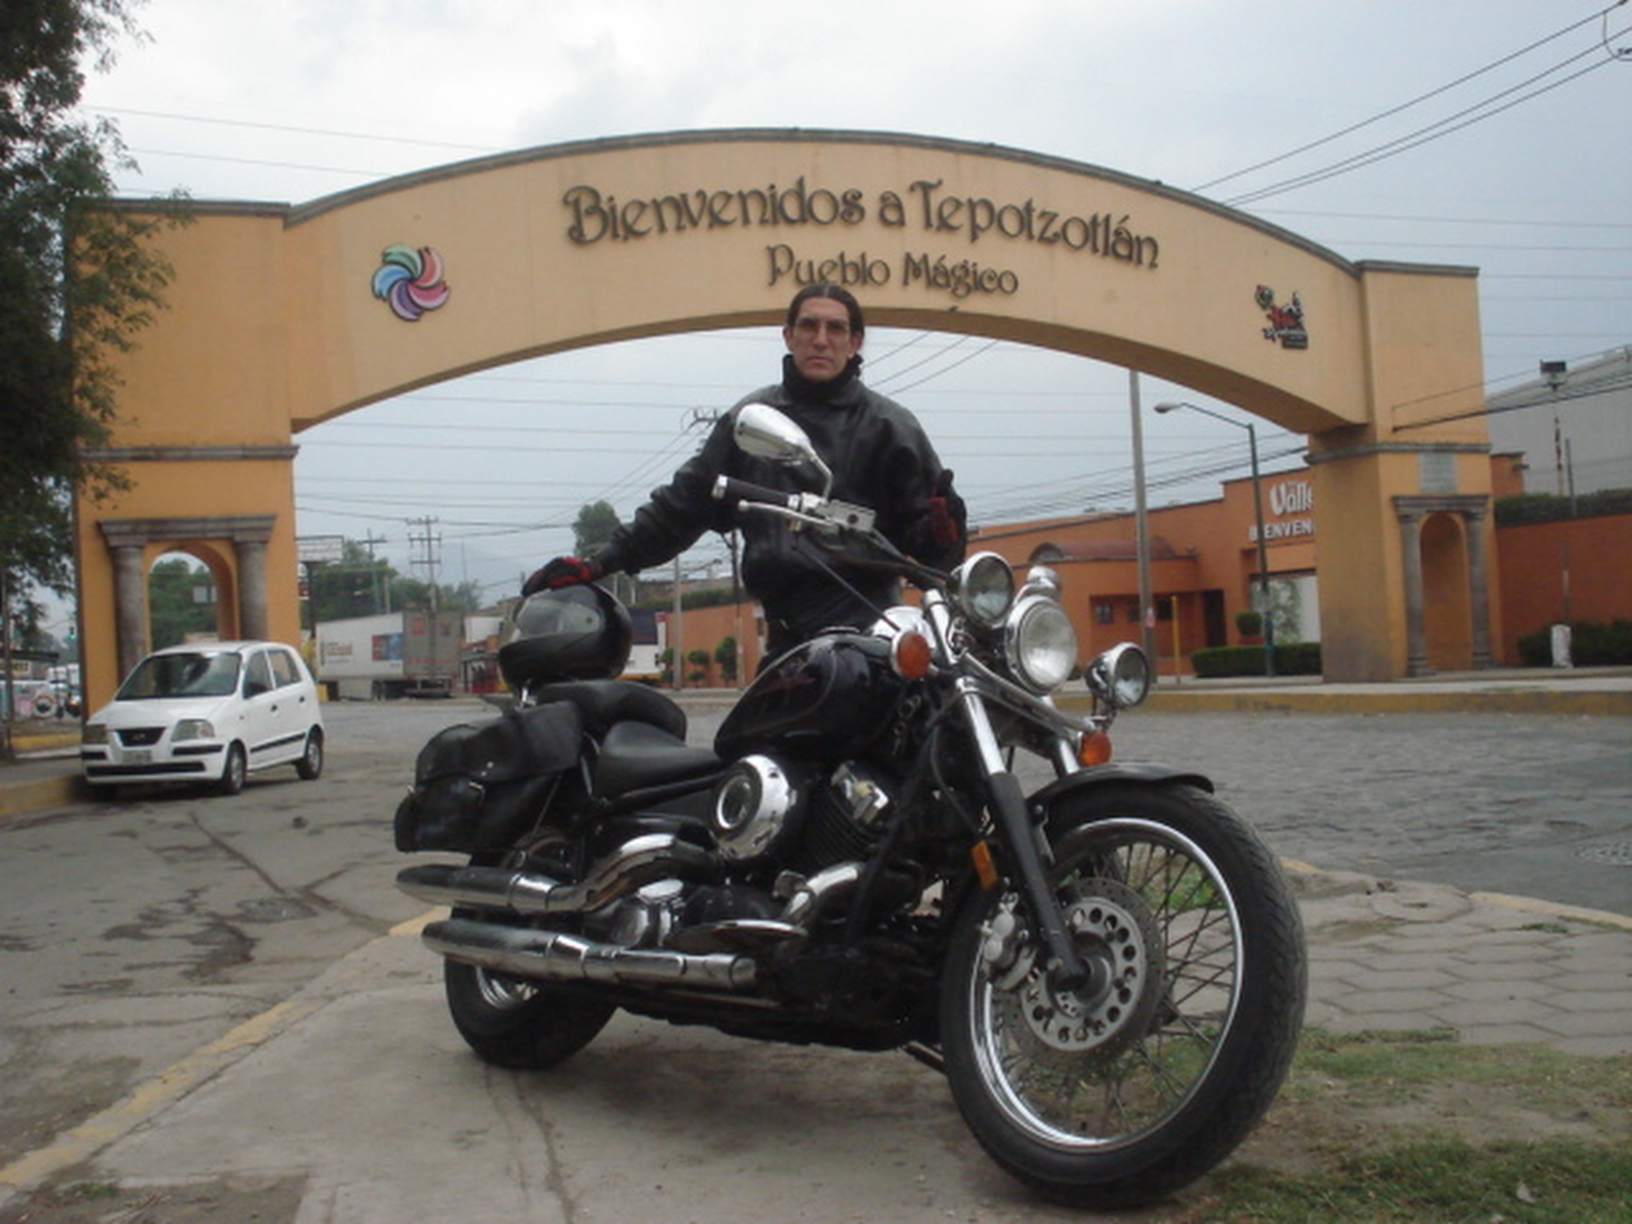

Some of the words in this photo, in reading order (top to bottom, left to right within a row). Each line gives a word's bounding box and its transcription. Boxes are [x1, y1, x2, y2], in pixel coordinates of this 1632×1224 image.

[562, 174, 866, 246] Bienvenidos
[878, 189, 907, 228] a
[908, 178, 1161, 270] Tepotzotlán
[766, 243, 892, 287] Pueblo
[902, 251, 1020, 299] Mágico
[1248, 518, 1315, 542] BENVEN
